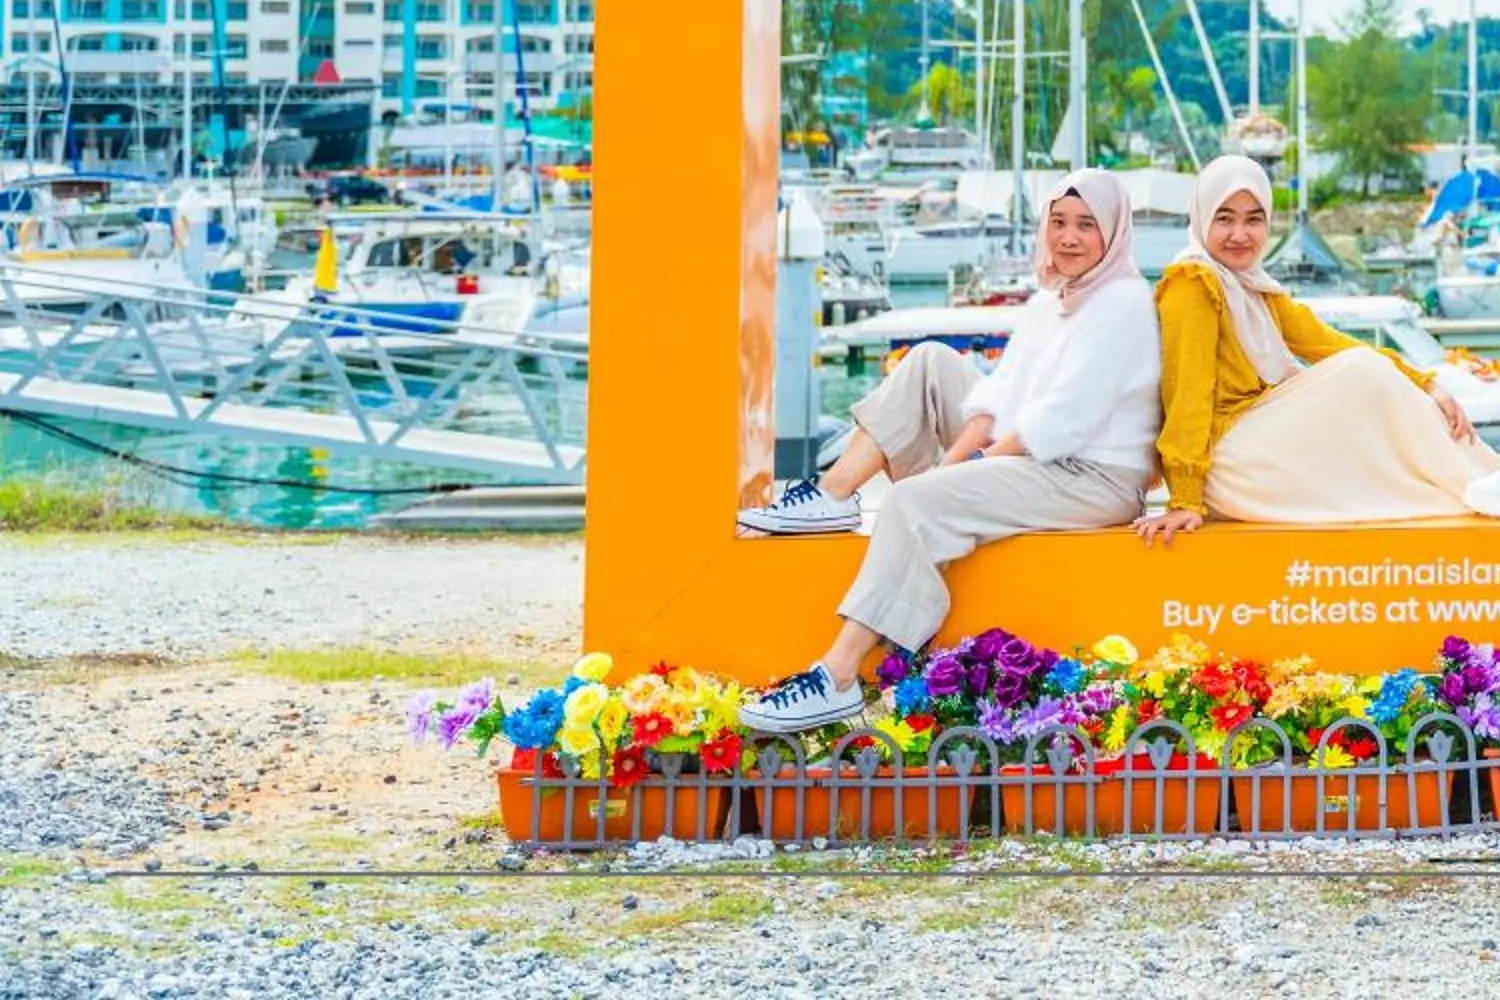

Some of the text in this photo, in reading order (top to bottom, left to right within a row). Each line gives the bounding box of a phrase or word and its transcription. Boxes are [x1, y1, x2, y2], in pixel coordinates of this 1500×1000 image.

[1163, 601, 1224, 634] Buy
[1232, 598, 1377, 627] e-tickets
[1387, 598, 1419, 624] at
